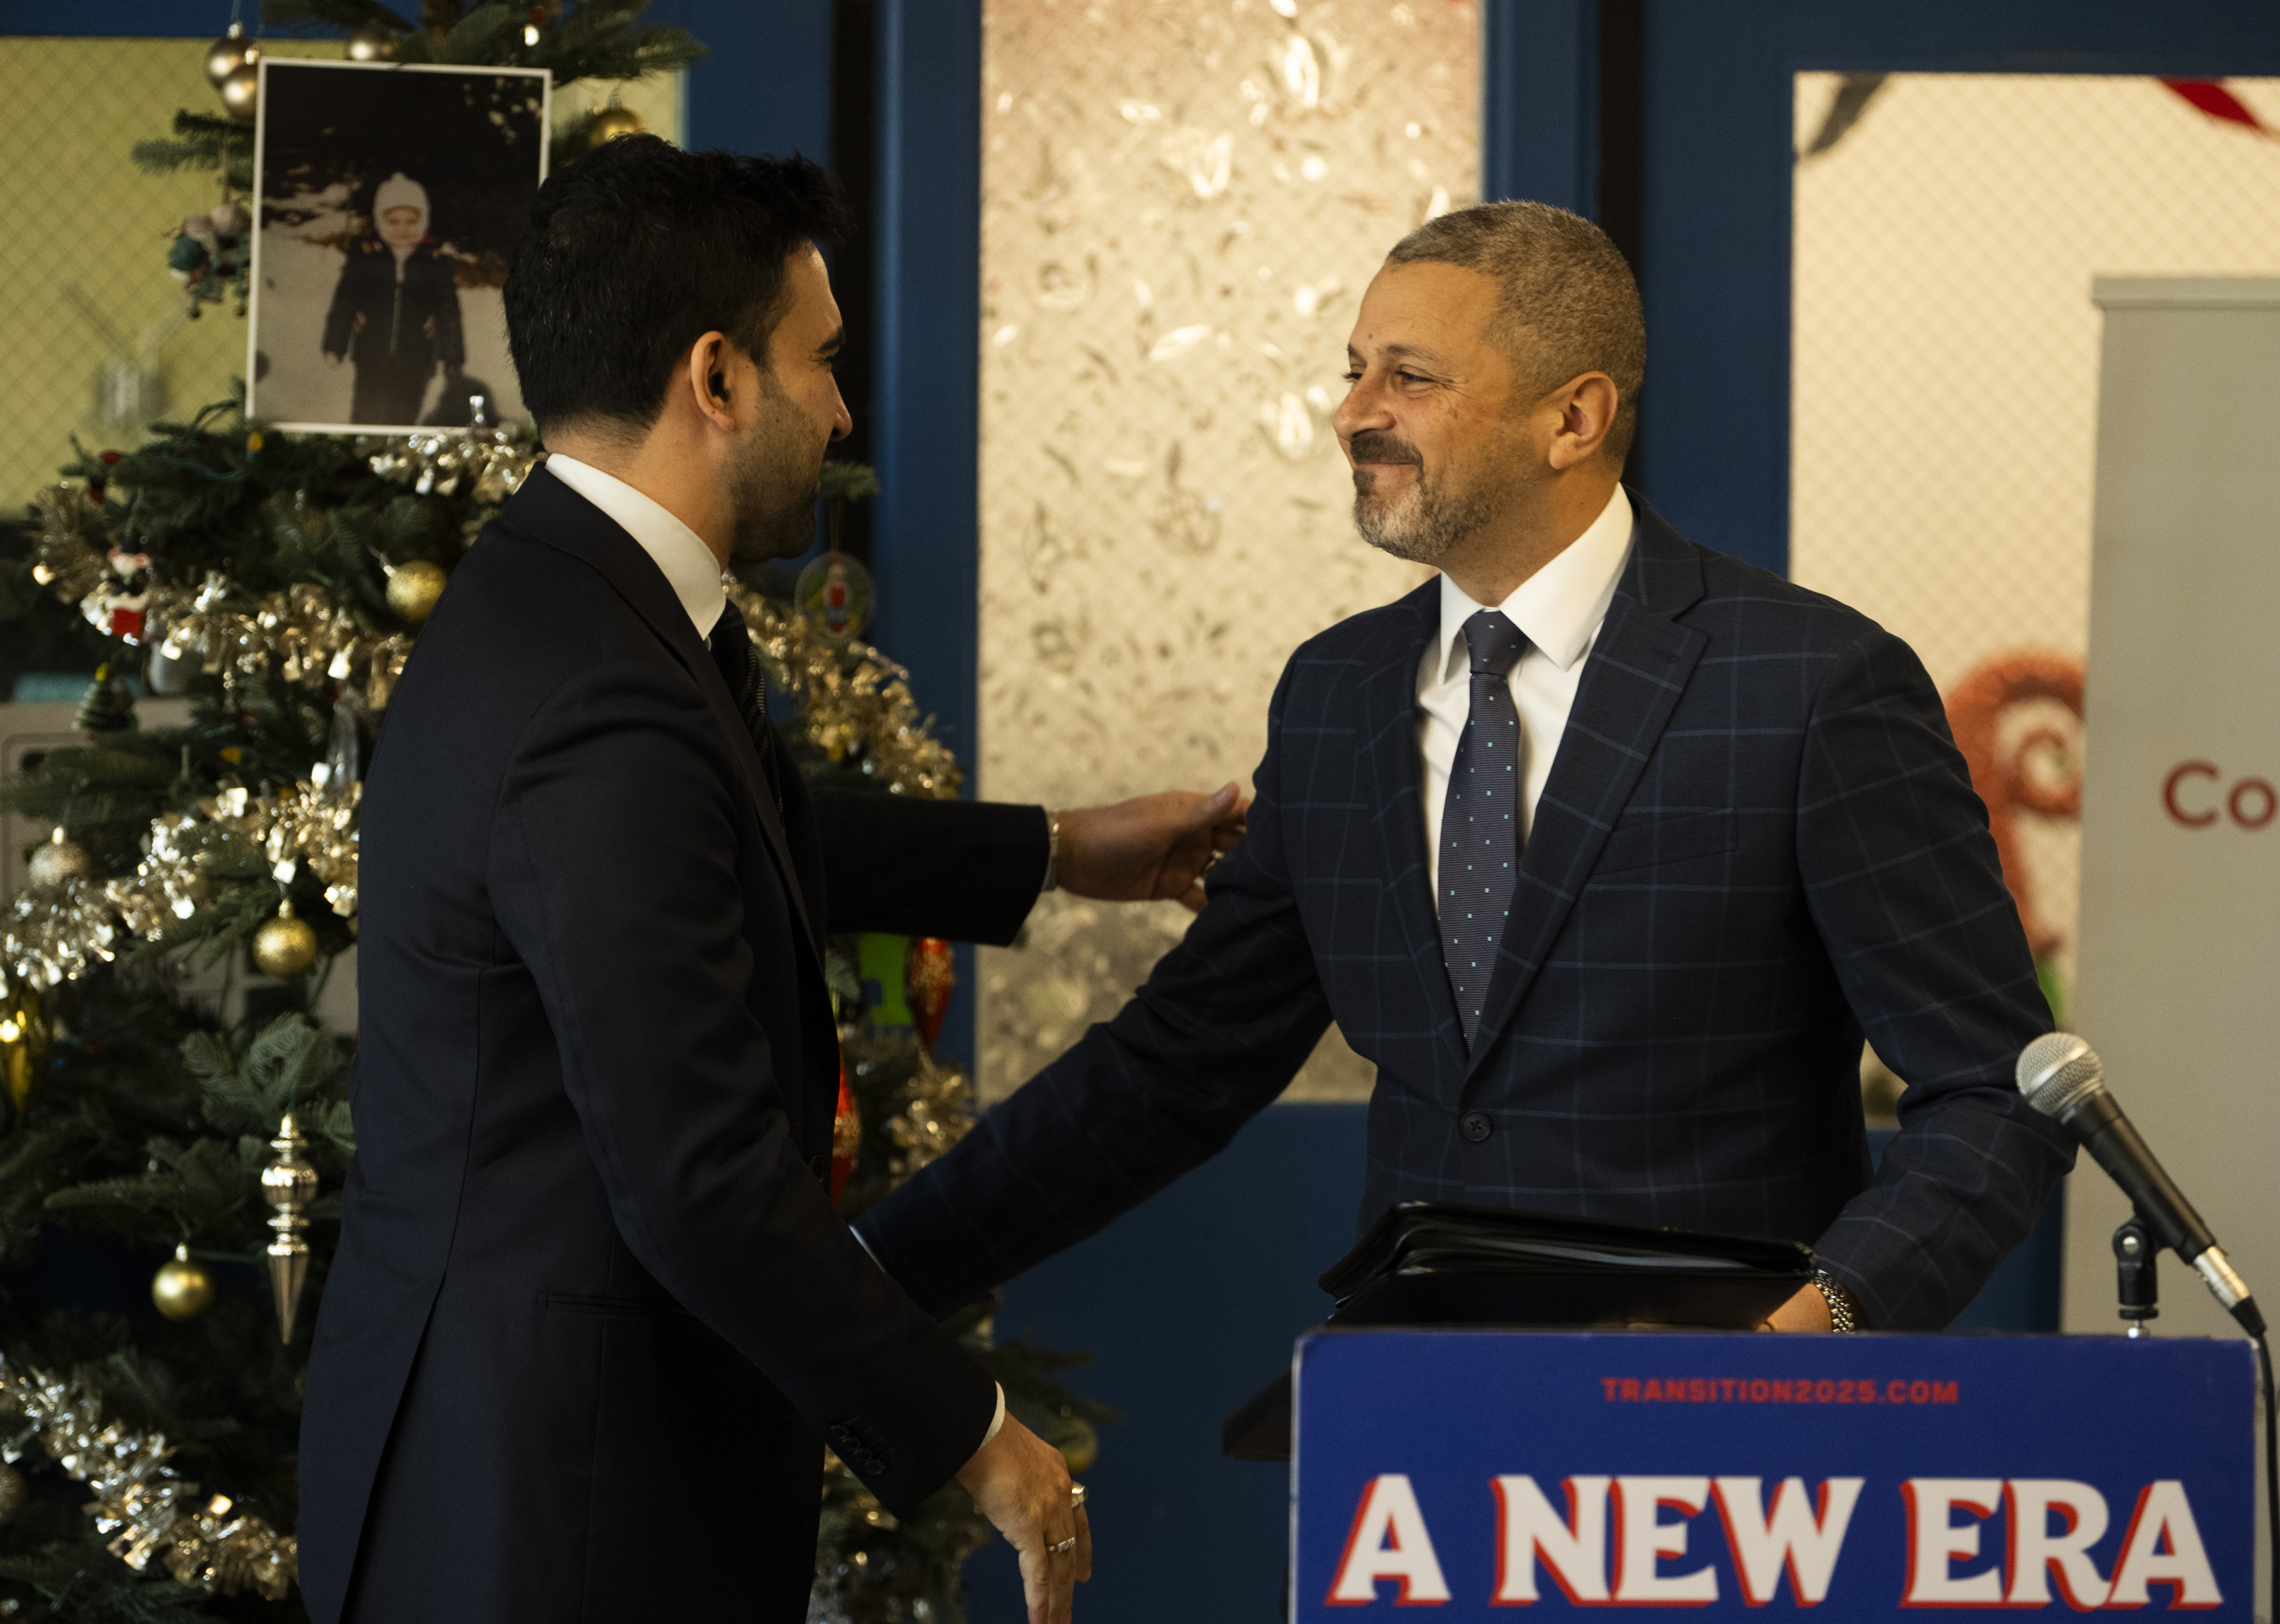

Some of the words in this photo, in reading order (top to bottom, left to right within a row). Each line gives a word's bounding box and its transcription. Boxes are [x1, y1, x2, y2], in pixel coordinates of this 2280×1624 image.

[2161, 760, 2279, 831] Co
[1601, 1377, 1959, 1404] TRANSITION2025.COM
[1324, 1474, 1452, 1608] A
[1487, 1474, 1866, 1608] NEW
[1898, 1477, 2225, 1613] ERA
